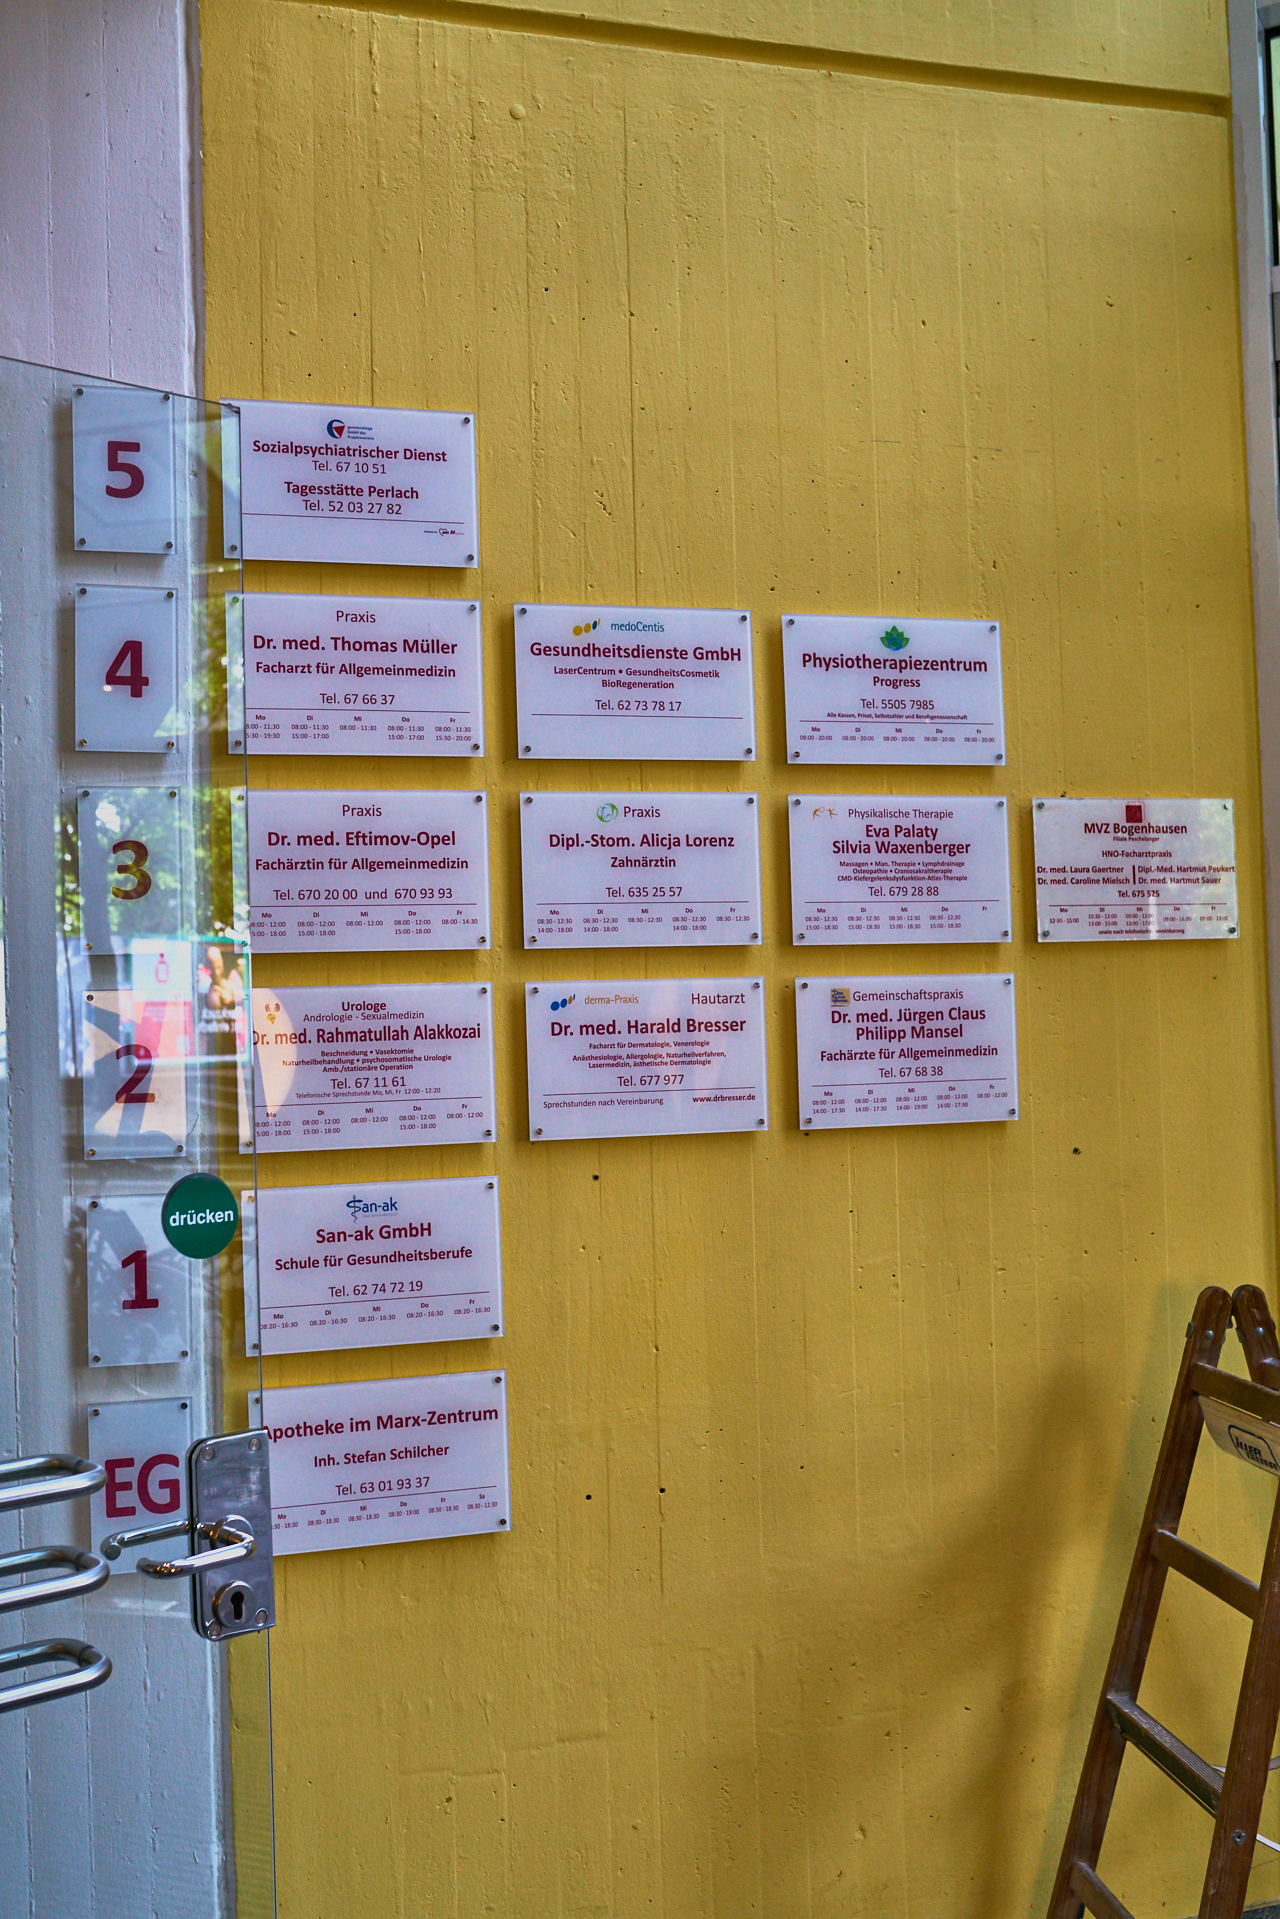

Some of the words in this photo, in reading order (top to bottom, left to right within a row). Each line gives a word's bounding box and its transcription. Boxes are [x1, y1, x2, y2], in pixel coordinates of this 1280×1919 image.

[253, 440, 400, 460] Sozialpsychiatrischer
[403, 448, 448, 463] Dienst
[105, 441, 145, 499] 5
[284, 481, 364, 498] Tagesstätte
[368, 486, 419, 500] Perlach
[302, 499, 324, 512] Tel.
[329, 501, 344, 513] 52
[348, 502, 364, 514] 03
[368, 502, 383, 514] 27
[387, 503, 402, 515] 82
[336, 610, 376, 624] Praxis
[611, 621, 665, 633] medoCentis
[254, 635, 277, 650] Dr.
[283, 636, 326, 651] med.
[330, 636, 398, 653] Thomas
[403, 639, 458, 655] Müller
[530, 642, 689, 660] Gesundheitsdienste
[693, 647, 742, 662] GmbH
[104, 640, 150, 698] 4
[256, 662, 313, 674] Facharzt
[315, 662, 336, 675] für
[339, 663, 456, 678] Allgemeinmedizin
[802, 652, 988, 673] Physiotherapiezentrum
[554, 666, 616, 676] LaserCentrum
[626, 668, 720, 678] GesundheitsCosmetik
[602, 679, 675, 690] BioRegeneration
[873, 676, 921, 690] Progress
[320, 693, 340, 704] Tel.
[344, 694, 359, 705] 67
[362, 694, 378, 705] 66
[381, 694, 396, 706] 37
[595, 699, 614, 711] Tel.
[618, 700, 632, 711] 62
[635, 700, 649, 711] 73
[652, 701, 666, 712] 78
[669, 701, 682, 712] 17
[860, 698, 879, 709] Tel.
[881, 699, 907, 710] 5505
[910, 700, 935, 711] 7985
[342, 804, 383, 817] Praxis
[624, 806, 661, 818] Praxis
[848, 808, 911, 820] Physikalische
[912, 809, 954, 821] Therapie
[866, 824, 890, 838] Eva
[894, 824, 939, 841] Palaty
[1084, 823, 1111, 834] MVZ
[1113, 822, 1188, 836] Bogenhausen
[268, 832, 291, 847] Dr.
[297, 831, 340, 847] med.
[346, 831, 456, 849] Eftimov-Opel
[549, 833, 636, 851] Dipl.-Stom.
[640, 833, 681, 851] Alicja
[686, 834, 735, 848] Lorenz
[833, 840, 871, 854] Silvia
[875, 839, 971, 857] Waxenberger
[1102, 850, 1173, 859] HNO-Facharztpraxis
[256, 858, 325, 871] Fachärztin
[328, 858, 348, 870] für
[351, 857, 469, 873] Allgemeinmedizin
[611, 856, 676, 868] Zahnärztin
[1138, 865, 1176, 874] Dipl.-Med.
[1177, 866, 1207, 874] Hartmut
[111, 840, 152, 900] 3
[1037, 866, 1048, 874] Dr.
[1050, 866, 1069, 874] med.
[1070, 866, 1091, 874] Laura
[1092, 866, 1125, 874] Gaertner
[1050, 877, 1069, 885] med.
[1070, 877, 1101, 885] Caroline
[1102, 877, 1131, 885] Mielsch
[1138, 877, 1149, 885] Dr.
[1150, 877, 1168, 885] med.
[1201, 876, 1222, 885] Sauer
[273, 889, 294, 901] Tel.
[298, 889, 321, 901] 670
[325, 889, 340, 901] 20
[343, 889, 358, 900] 00
[365, 888, 388, 900] und
[395, 888, 417, 900] 670
[420, 888, 435, 899] 93
[438, 888, 453, 899] 93
[605, 887, 625, 898] Tel.
[628, 887, 649, 898] 635
[652, 887, 666, 898] 25
[669, 886, 683, 898] 57
[868, 886, 886, 897] Tel.
[889, 886, 909, 897] 679
[911, 886, 924, 897] 28
[926, 886, 940, 897] 88
[585, 994, 640, 1005] derma-Praxis
[692, 993, 746, 1005] Hautarzt
[853, 989, 964, 1002] Gemeinschaftspraxis
[342, 1001, 387, 1012] Urologe
[303, 1013, 353, 1023] Andrologie
[361, 1010, 425, 1021] Sexualmedizin
[831, 1010, 852, 1024] Dr.
[856, 1008, 893, 1024] med.
[897, 1008, 944, 1024] Jürgen
[948, 1006, 986, 1021] Claus
[275, 1028, 312, 1045] med.
[317, 1025, 410, 1044] Rahmatullah
[413, 1023, 481, 1041] Alakkozai
[551, 1022, 574, 1037] Dr.
[579, 1019, 622, 1036] med.
[627, 1018, 681, 1035] Harald
[687, 1018, 747, 1033] Bresser
[856, 1026, 907, 1042] Philipp
[911, 1023, 963, 1040] Mansel
[628, 1041, 672, 1049] Dermatologie,
[673, 1040, 710, 1048] Venerologie
[821, 1050, 876, 1062] Fachärzte
[879, 1048, 896, 1060] für
[898, 1045, 998, 1062] Allgemeinmedizin
[115, 1044, 155, 1104] 2
[330, 1078, 351, 1090] Tel.
[355, 1078, 370, 1089] 67
[374, 1077, 388, 1088] 11
[392, 1076, 407, 1088] 61
[543, 1100, 597, 1110] Sprechstunden
[598, 1099, 616, 1107] nach
[616, 1098, 664, 1106] Vereinbarung
[692, 1093, 756, 1103] www.drbresser.de
[346, 1196, 398, 1216] San-ak
[168, 1207, 234, 1228] drücken
[316, 1226, 375, 1244] San-ak
[379, 1222, 432, 1240] GmbH
[276, 1256, 320, 1271] Schule
[323, 1255, 344, 1268] für
[347, 1246, 473, 1266] Gesundheitsberufe
[121, 1250, 159, 1309] 1
[328, 1285, 350, 1298] Tel.
[353, 1284, 368, 1296] 62
[372, 1283, 387, 1295] 74
[390, 1282, 405, 1294] 72
[409, 1280, 423, 1292] 19
[350, 1418, 371, 1433] im
[377, 1409, 499, 1430] Marx-Zentrum
[314, 1454, 340, 1468] Inh.
[344, 1450, 386, 1465] Stefan
[390, 1445, 450, 1461] Schilcher
[104, 1453, 181, 1518] EG
